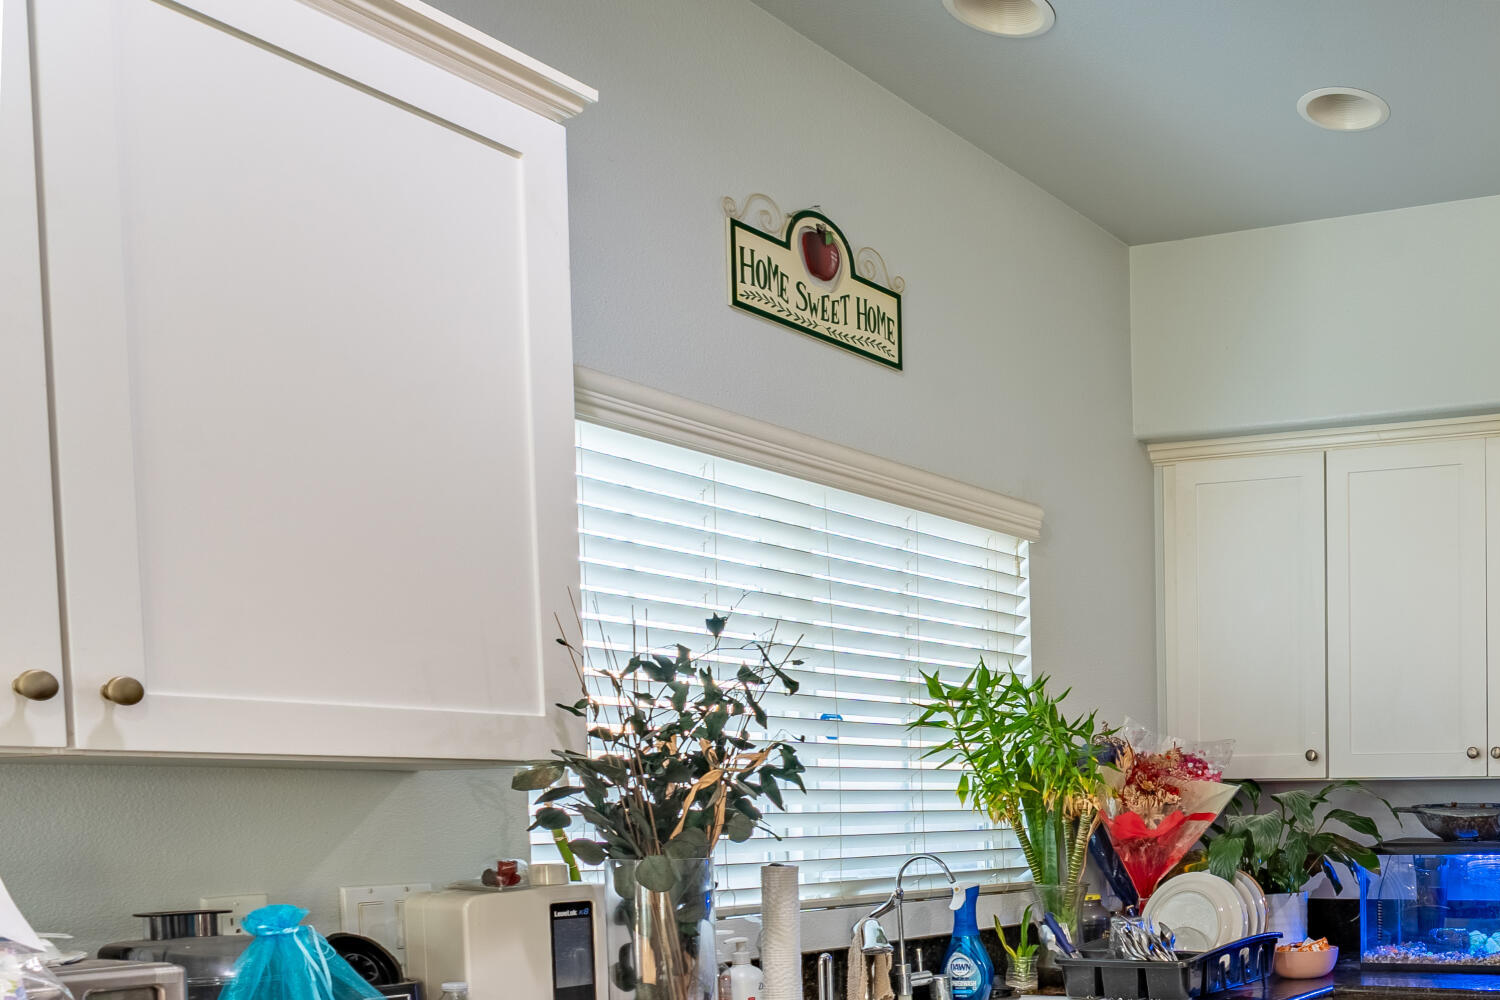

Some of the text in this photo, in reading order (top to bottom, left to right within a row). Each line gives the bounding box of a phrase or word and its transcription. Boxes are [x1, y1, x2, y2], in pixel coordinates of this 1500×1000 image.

[739, 245, 896, 346] HOME SWEET HOME
[950, 963, 971, 972] DAWN
